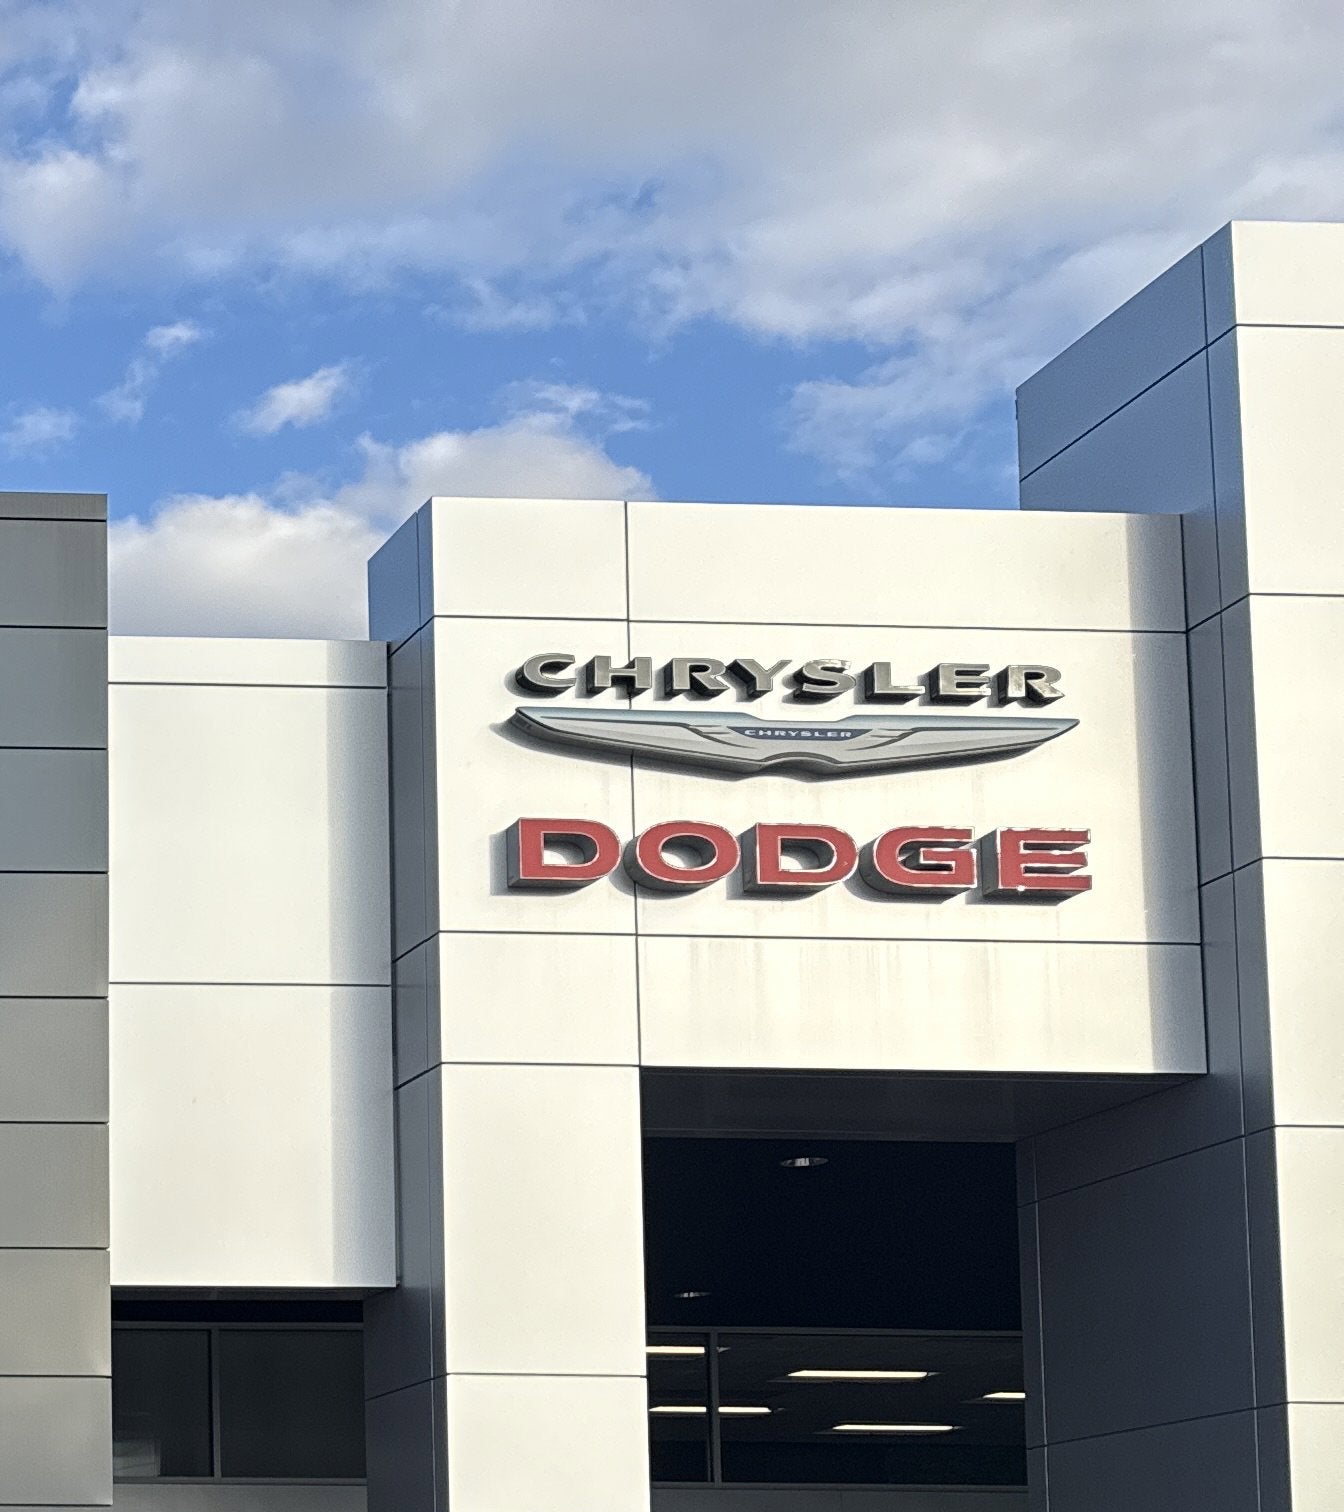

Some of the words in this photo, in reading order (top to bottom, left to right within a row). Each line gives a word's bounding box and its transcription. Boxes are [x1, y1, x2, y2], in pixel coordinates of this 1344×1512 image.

[514, 653, 1065, 703] CHRYSLER
[744, 729, 852, 738] CHRYSLER
[510, 817, 1093, 900] DODGE
